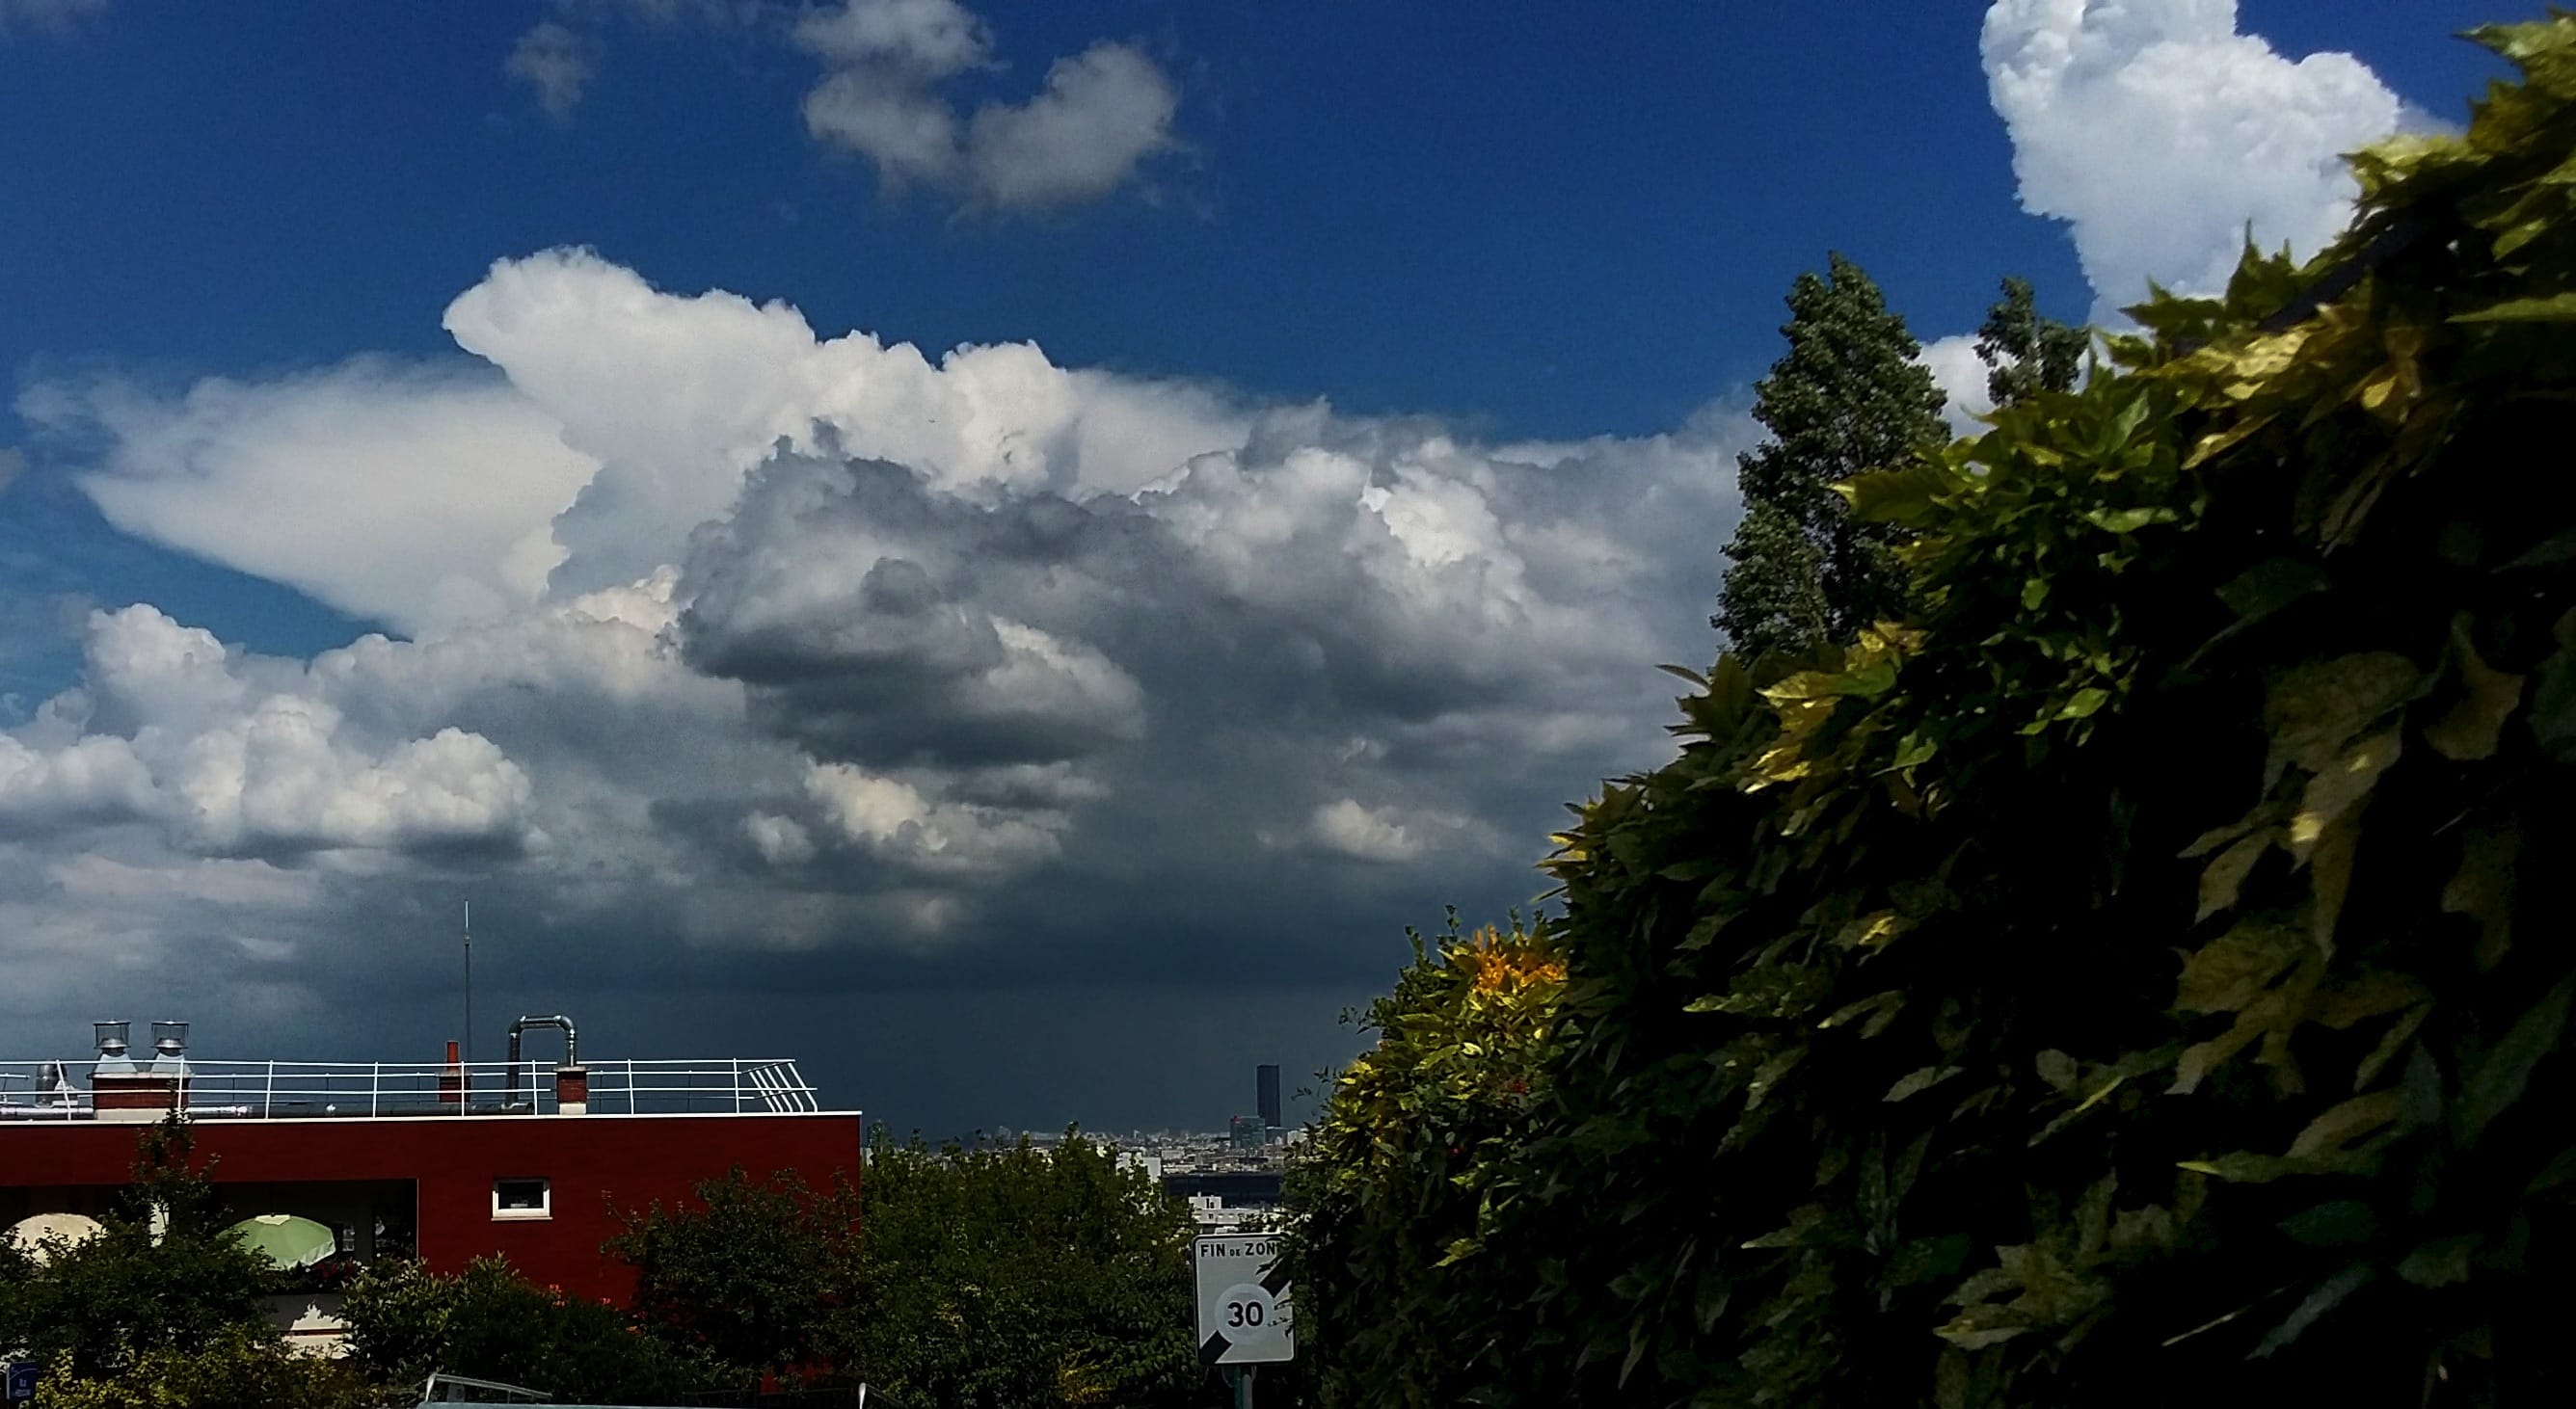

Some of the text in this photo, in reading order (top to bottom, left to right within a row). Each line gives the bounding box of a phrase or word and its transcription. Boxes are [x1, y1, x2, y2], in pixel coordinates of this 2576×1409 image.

[1200, 1243, 1225, 1257] FIN
[1245, 1242, 1275, 1256] ZON
[1227, 1301, 1264, 1327] 30
